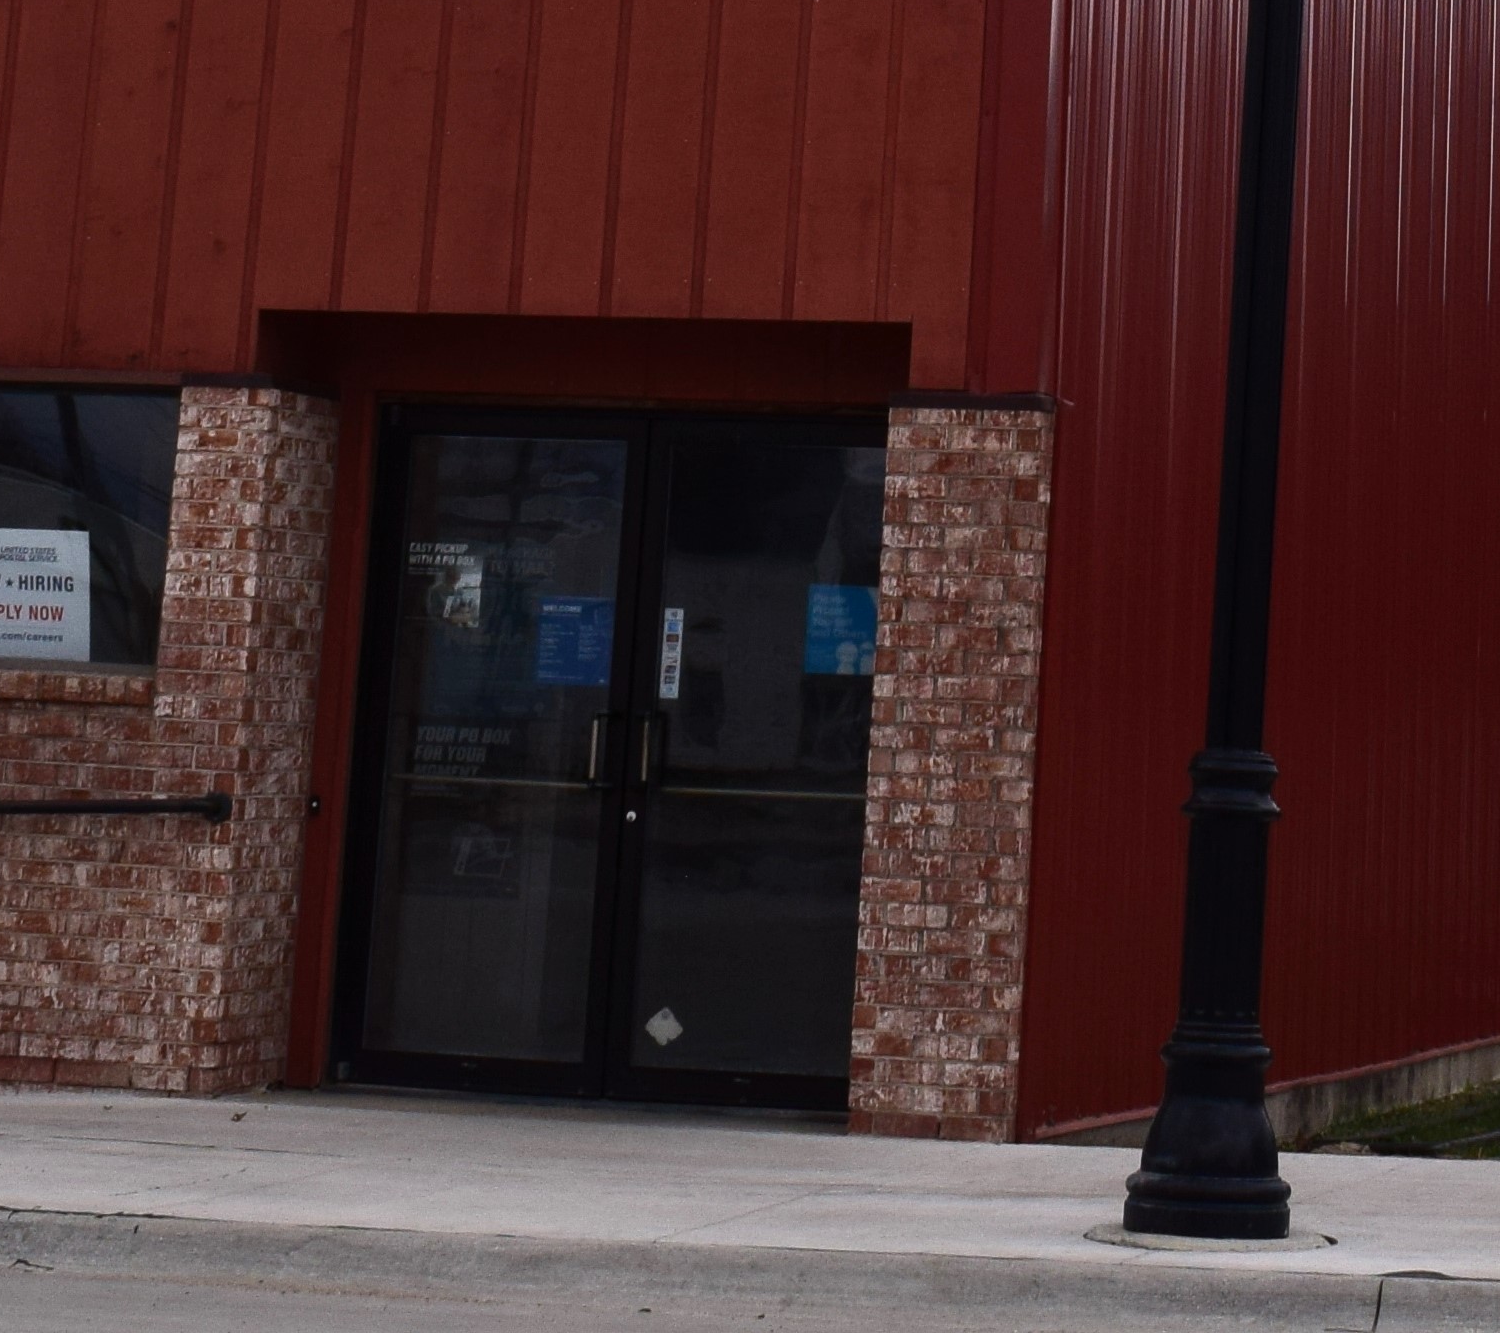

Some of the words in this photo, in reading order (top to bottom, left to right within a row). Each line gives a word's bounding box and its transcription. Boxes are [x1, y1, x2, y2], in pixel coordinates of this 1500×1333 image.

[0, 546, 28, 554] UNITED
[30, 547, 56, 555] STATES
[409, 542, 433, 553] EASY
[434, 542, 469, 554] PICKUP
[409, 554, 433, 565] WITH
[456, 555, 475, 566] BOX
[18, 574, 74, 592] HIRING
[29, 605, 64, 621] NOW
[542, 604, 582, 613] WELCOME
[417, 725, 456, 742] YOUR
[458, 727, 480, 744] PO
[481, 728, 512, 746] BOX
[414, 744, 443, 761] FOR
[447, 745, 487, 763] YOUR
